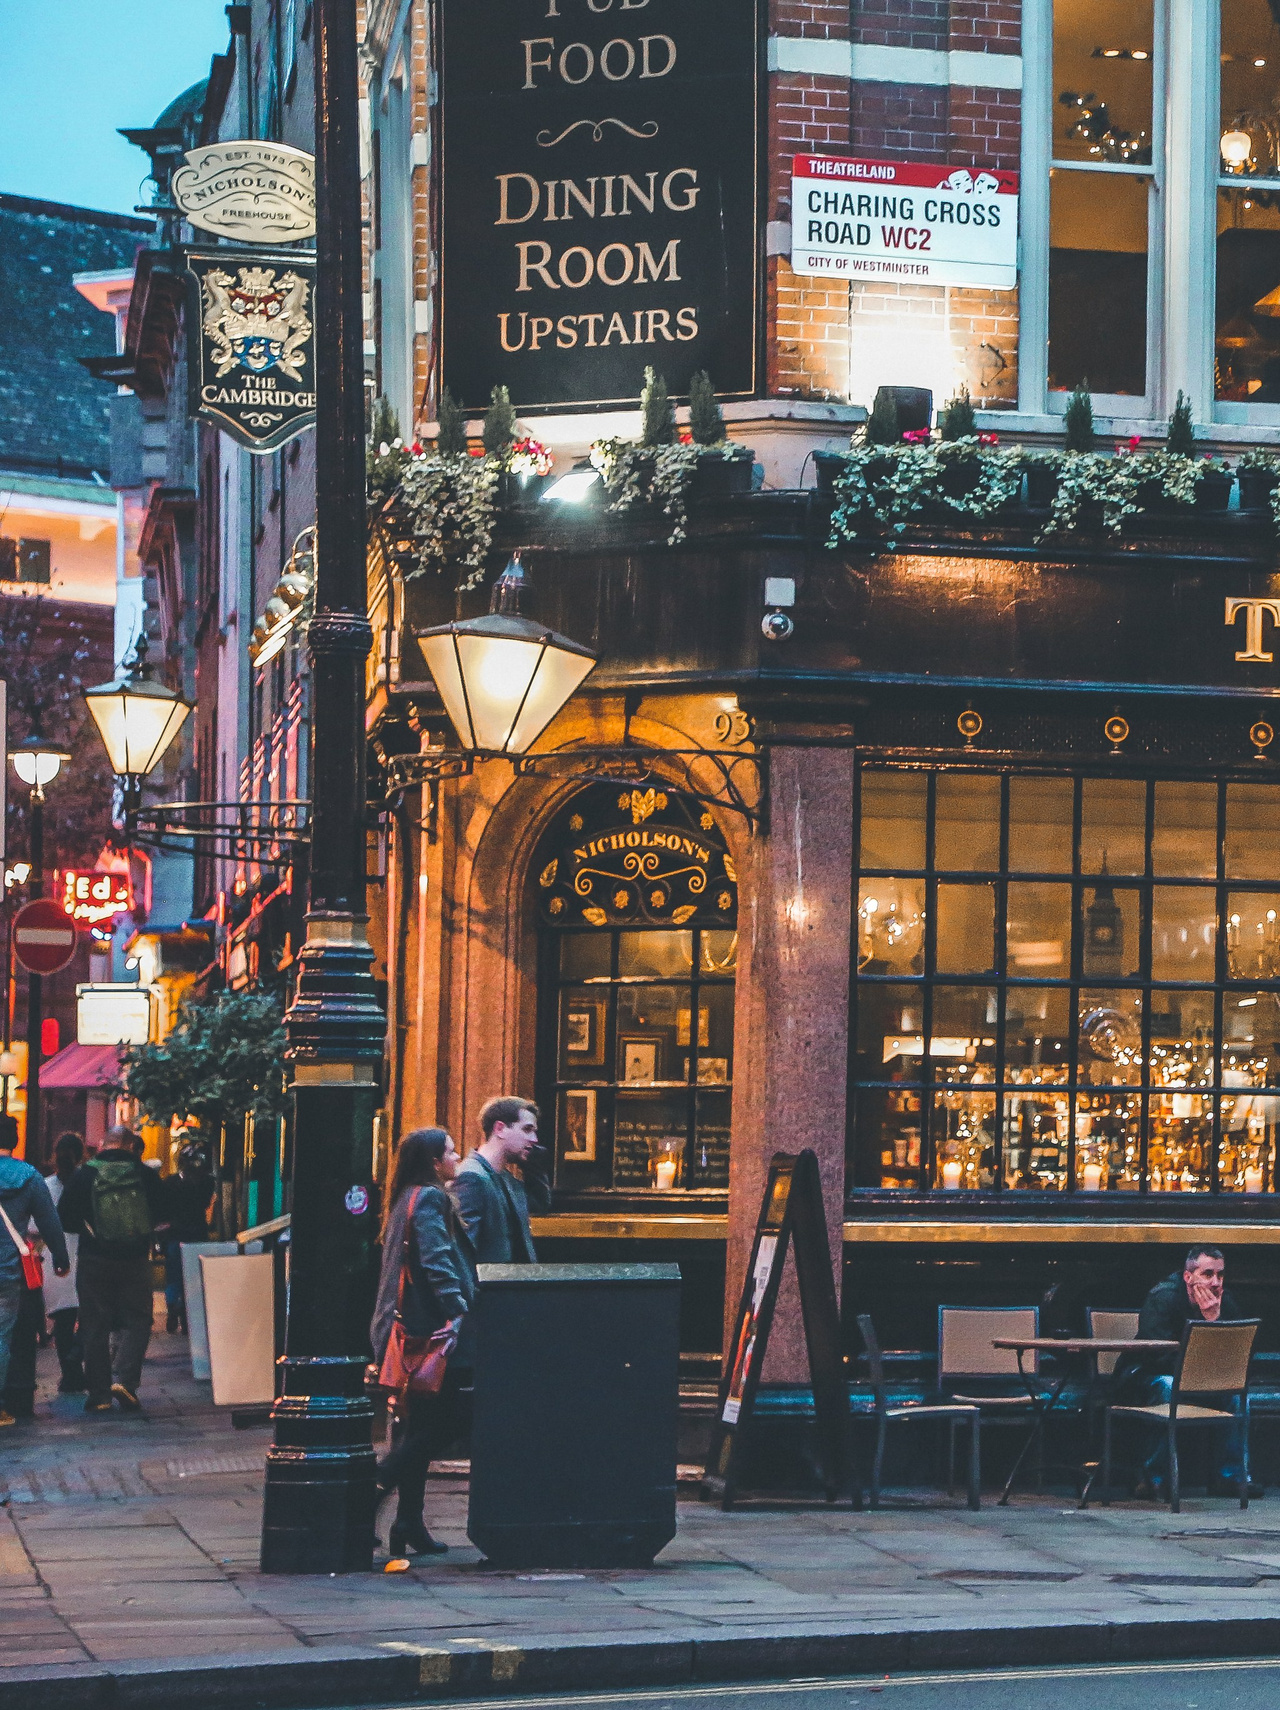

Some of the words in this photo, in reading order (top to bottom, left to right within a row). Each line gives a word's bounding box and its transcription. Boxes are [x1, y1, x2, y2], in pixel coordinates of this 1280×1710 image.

[520, 33, 678, 90] FOOD
[256, 152, 286, 165] 1873
[808, 159, 896, 180] THEATRELAND
[494, 167, 701, 225] DINING
[808, 190, 914, 221] CHARING
[924, 200, 1001, 227] CROSS
[222, 208, 292, 221] FREEHOUSE
[808, 220, 871, 246] ROAD
[881, 225, 932, 251] WC2
[514, 239, 682, 292] ROOM
[808, 256, 832, 268] CITY
[835, 258, 849, 269] OF
[852, 259, 930, 276] WESTMINSTER
[496, 306, 699, 353] UPSTAIRS
[201, 384, 317, 409] CAMBRIDGE
[240, 374, 277, 390] THE
[714, 710, 750, 746] 93
[573, 830, 710, 864] NICHOLSON'S
